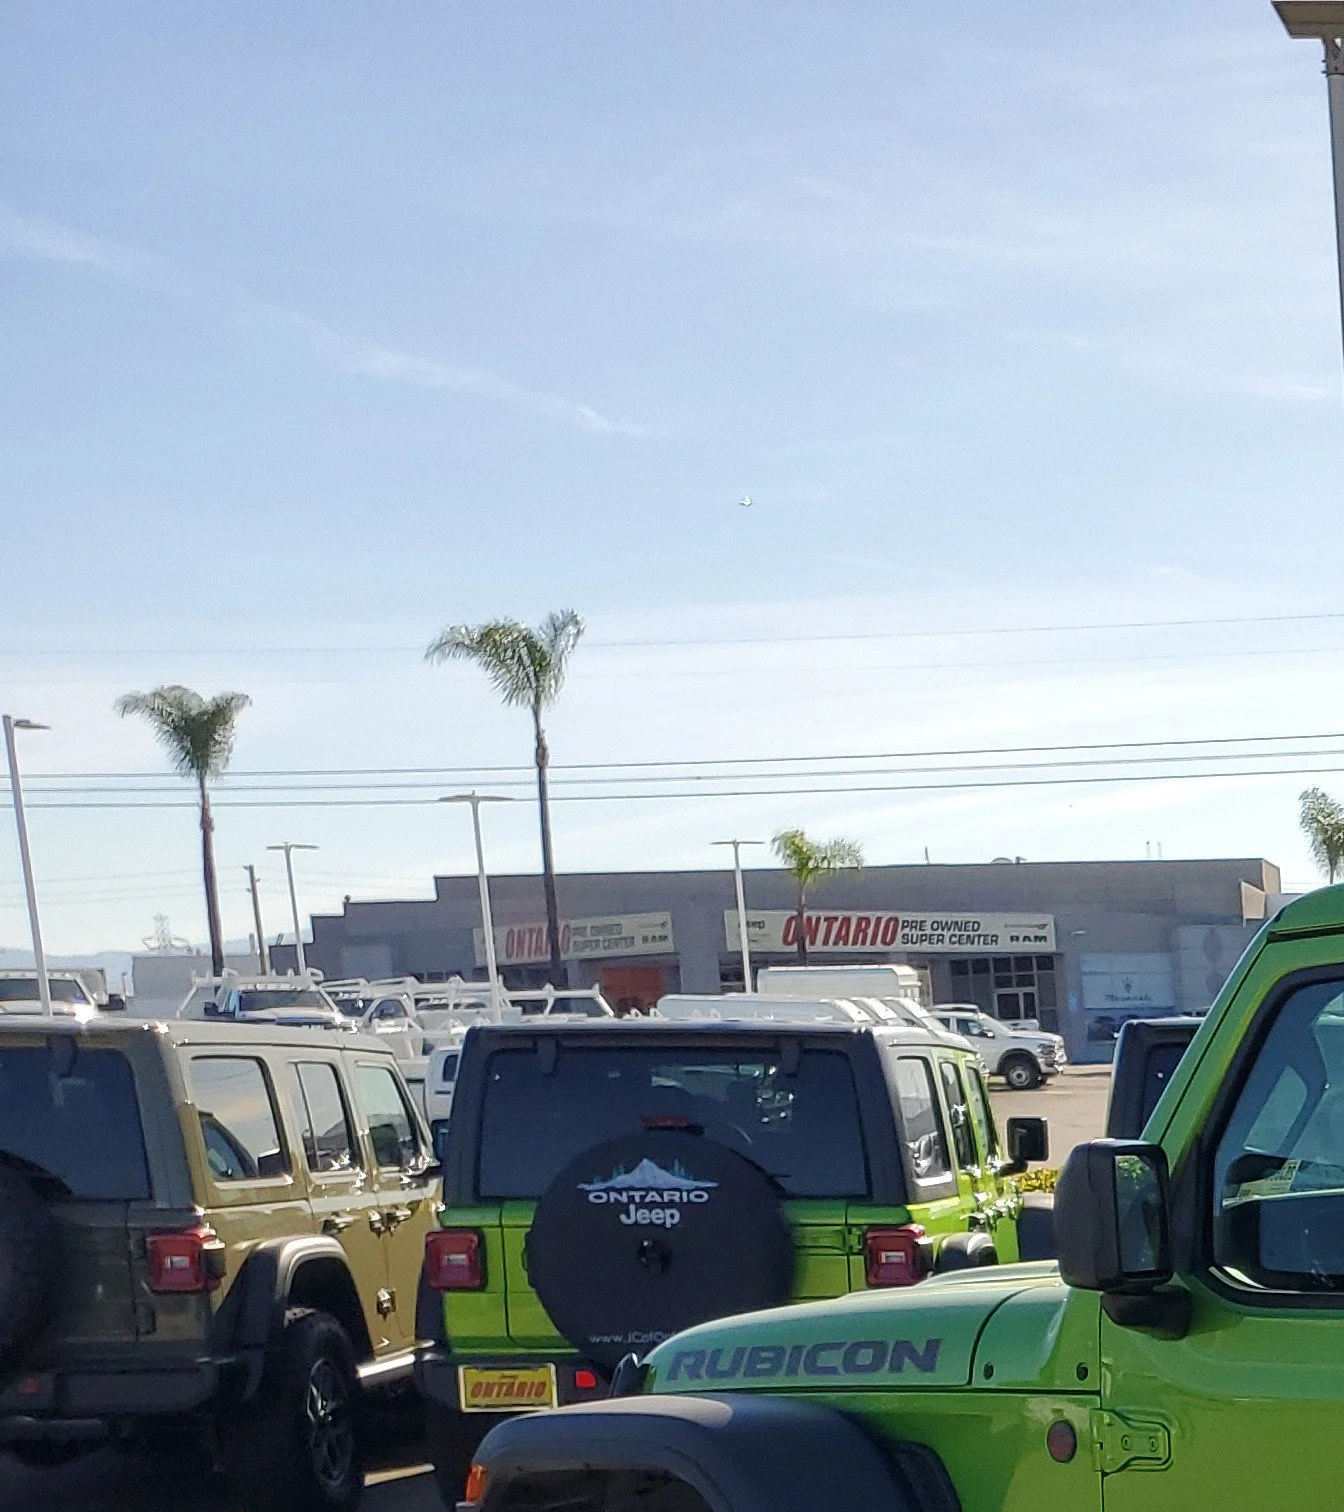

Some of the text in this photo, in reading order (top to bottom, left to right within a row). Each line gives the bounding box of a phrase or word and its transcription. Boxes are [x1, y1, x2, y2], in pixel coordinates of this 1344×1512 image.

[782, 915, 900, 946] ONTARIO
[901, 919, 980, 932] PRE OWNED
[901, 933, 998, 946] SUPER CENTER
[1009, 934, 1047, 943] RAM
[588, 1190, 709, 1203] ONTARIO
[619, 1203, 680, 1228] Jeep
[666, 1337, 943, 1381] RUBICON
[470, 1381, 548, 1398] ONTARIO
